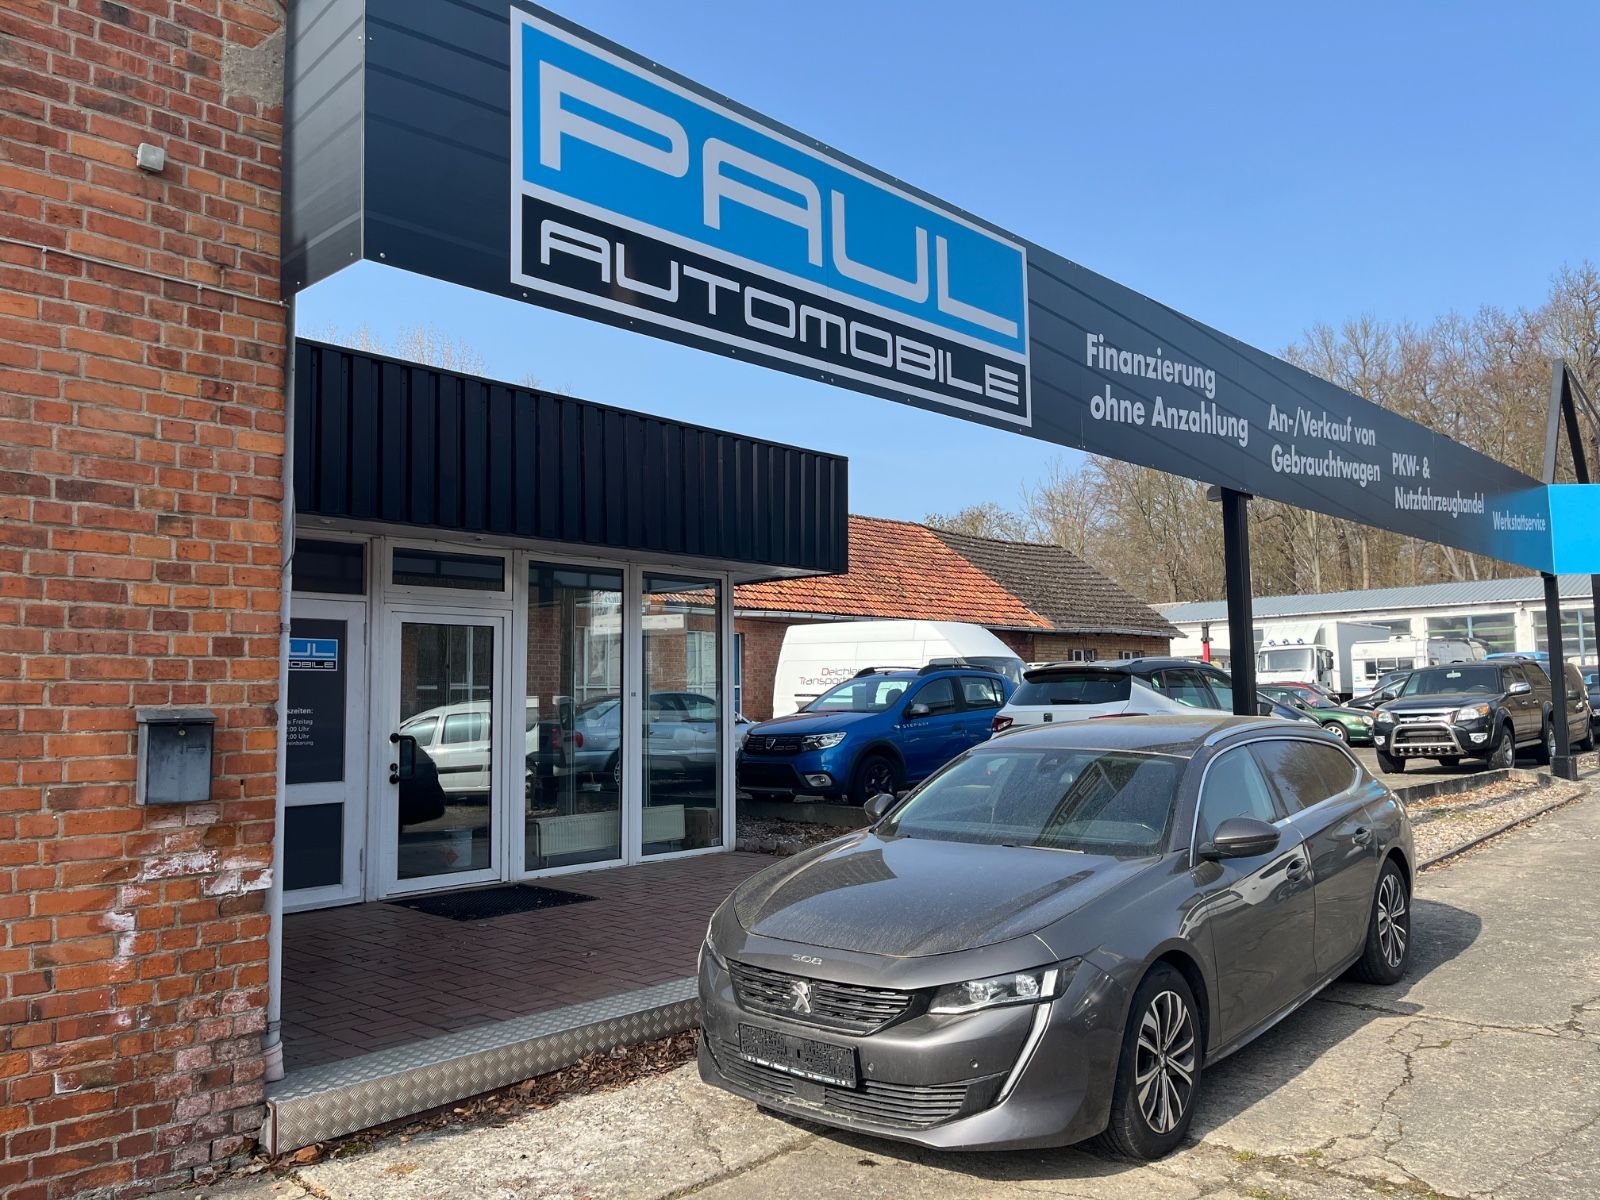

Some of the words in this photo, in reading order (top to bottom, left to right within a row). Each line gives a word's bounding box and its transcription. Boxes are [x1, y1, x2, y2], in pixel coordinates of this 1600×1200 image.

[539, 59, 1018, 339] PAUL
[540, 219, 1019, 405] AUTOMOBILE
[1086, 332, 1216, 399] Finanzierung
[1090, 384, 1145, 425] ohne
[1151, 396, 1249, 448] Anzahlung
[1268, 403, 1352, 443] An-/Verkauf
[1354, 426, 1376, 446] von
[1271, 444, 1381, 488] Gebrauchtwagen
[1392, 452, 1420, 477] PKW-
[1422, 456, 1431, 479] &
[1394, 485, 1485, 519] Nutzfahrzeughandel
[1492, 510, 1546, 532] Werkstattservice
